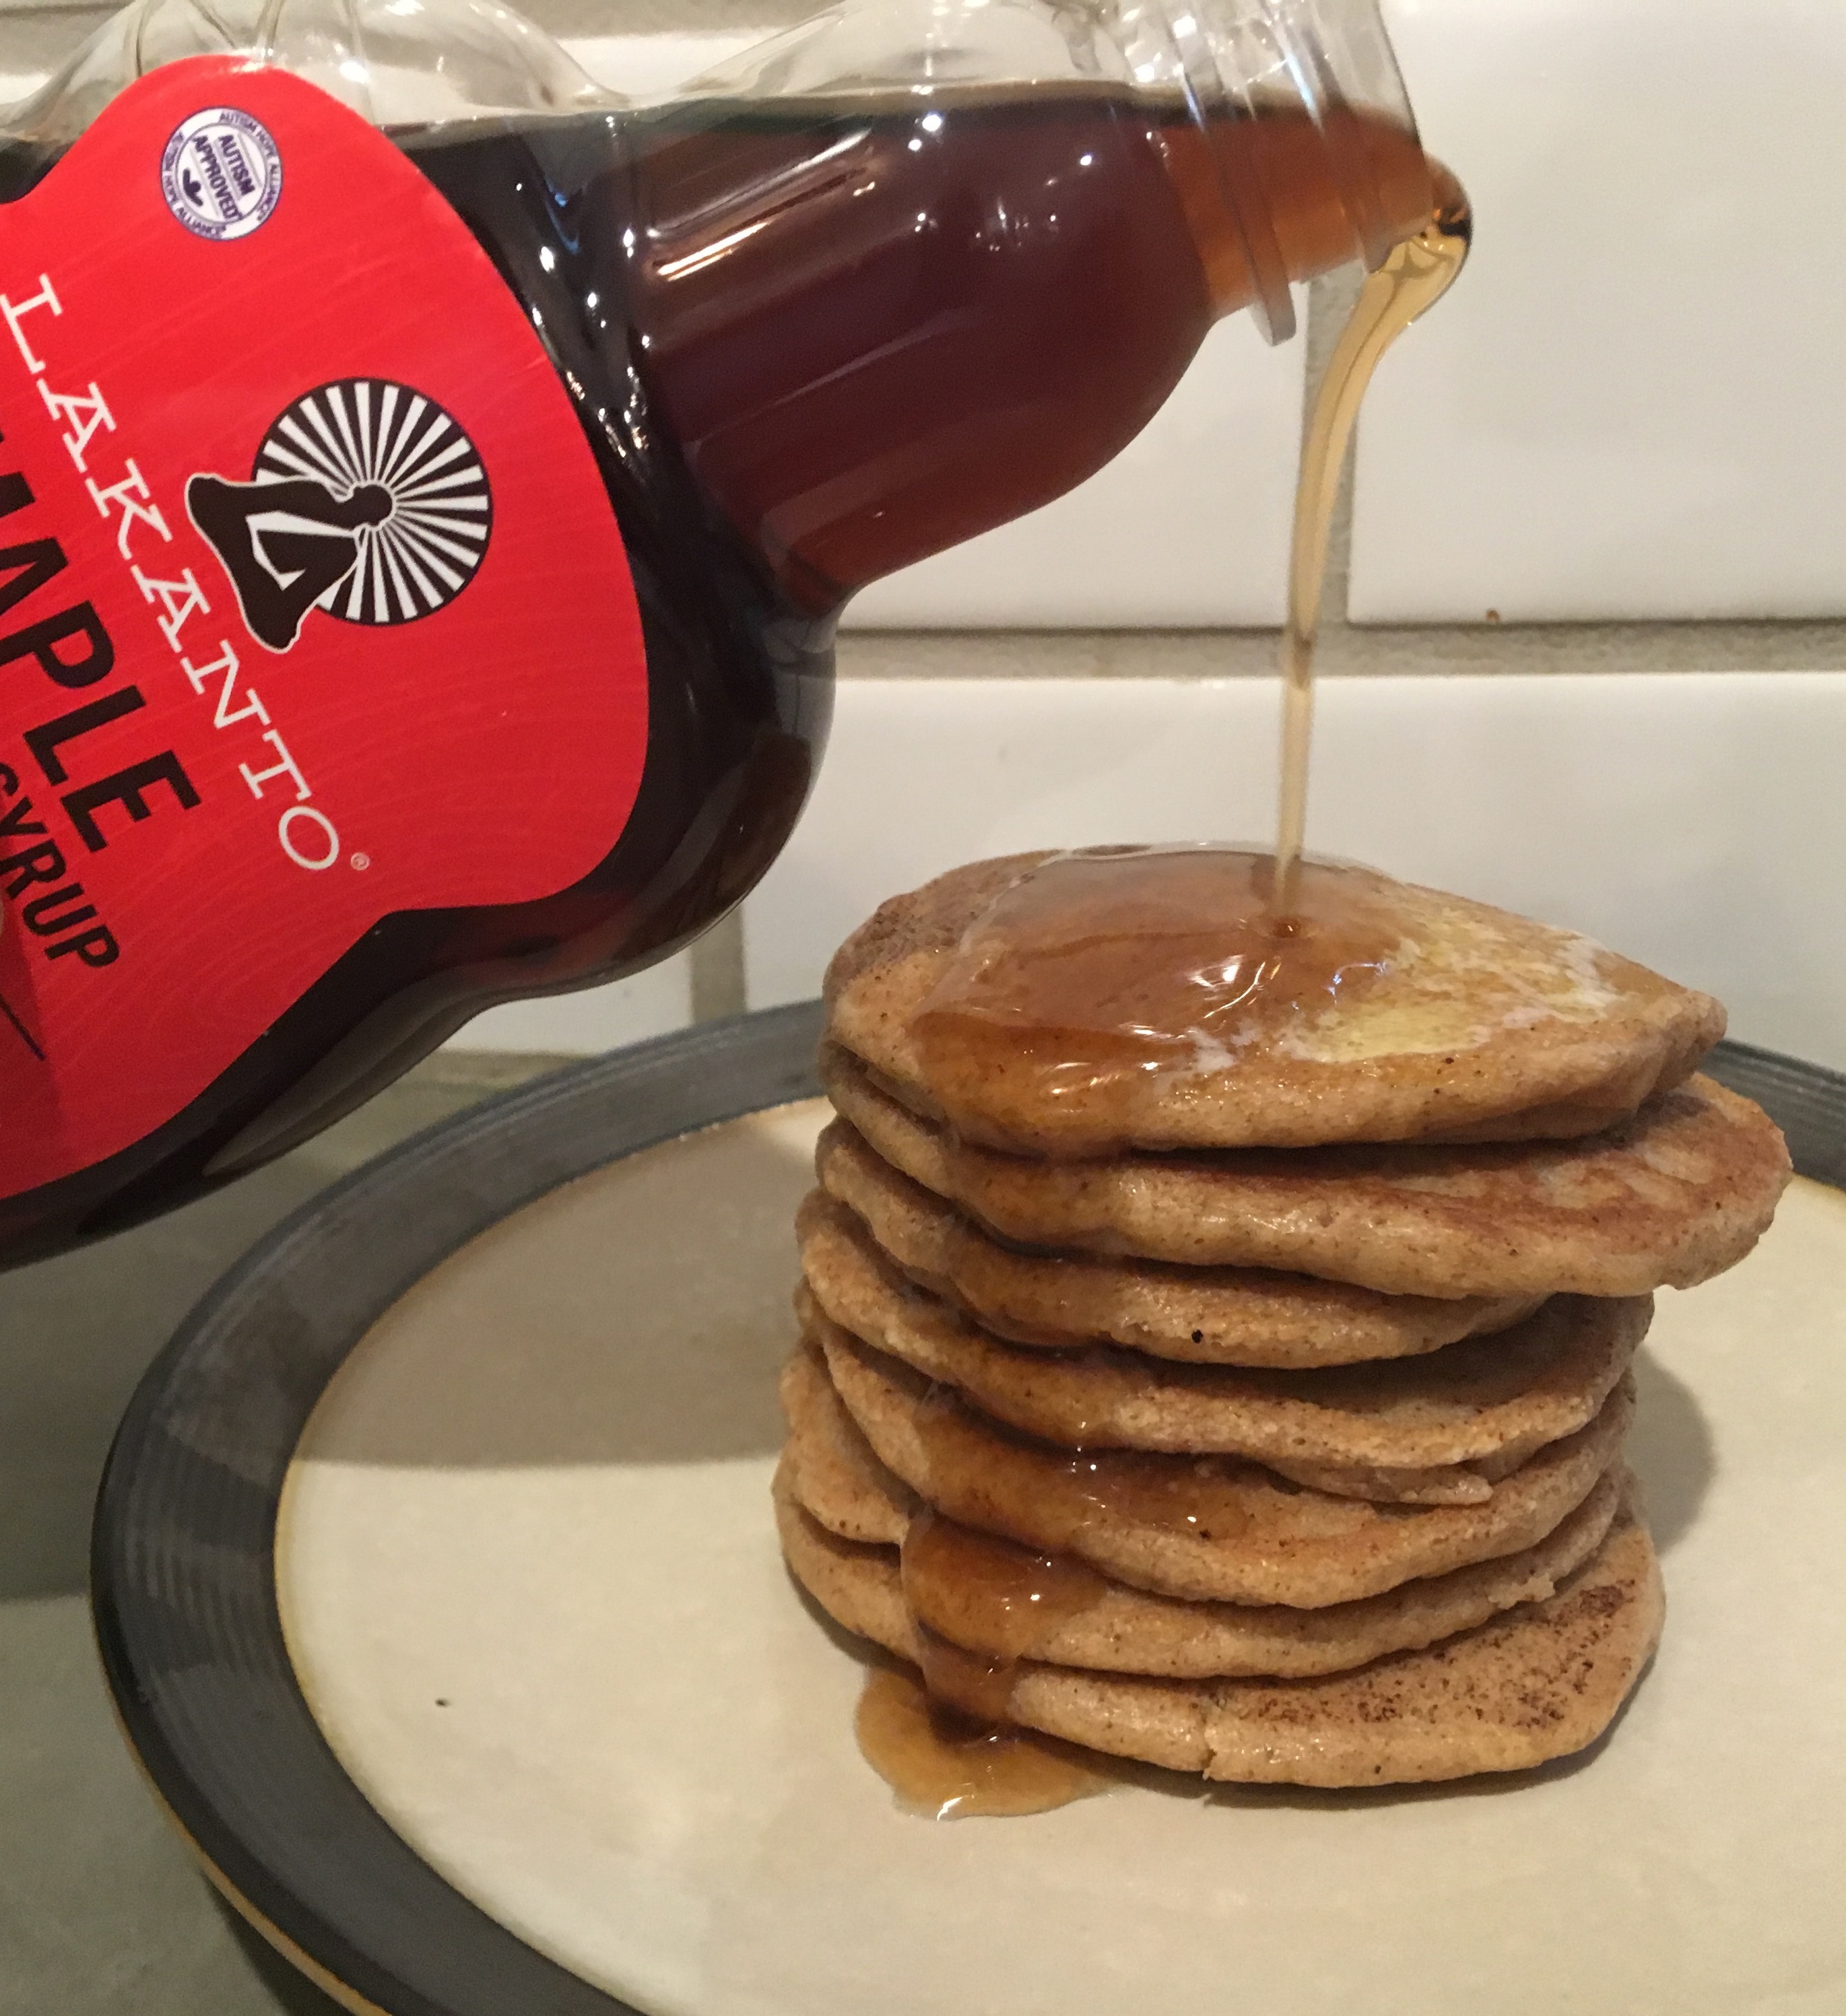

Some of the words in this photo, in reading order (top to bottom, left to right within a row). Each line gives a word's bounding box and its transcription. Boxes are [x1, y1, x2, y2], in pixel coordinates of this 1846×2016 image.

[218, 134, 256, 196] AUTISM
[0, 273, 339, 870] LAKANTO
[0, 430, 201, 853] APLE
